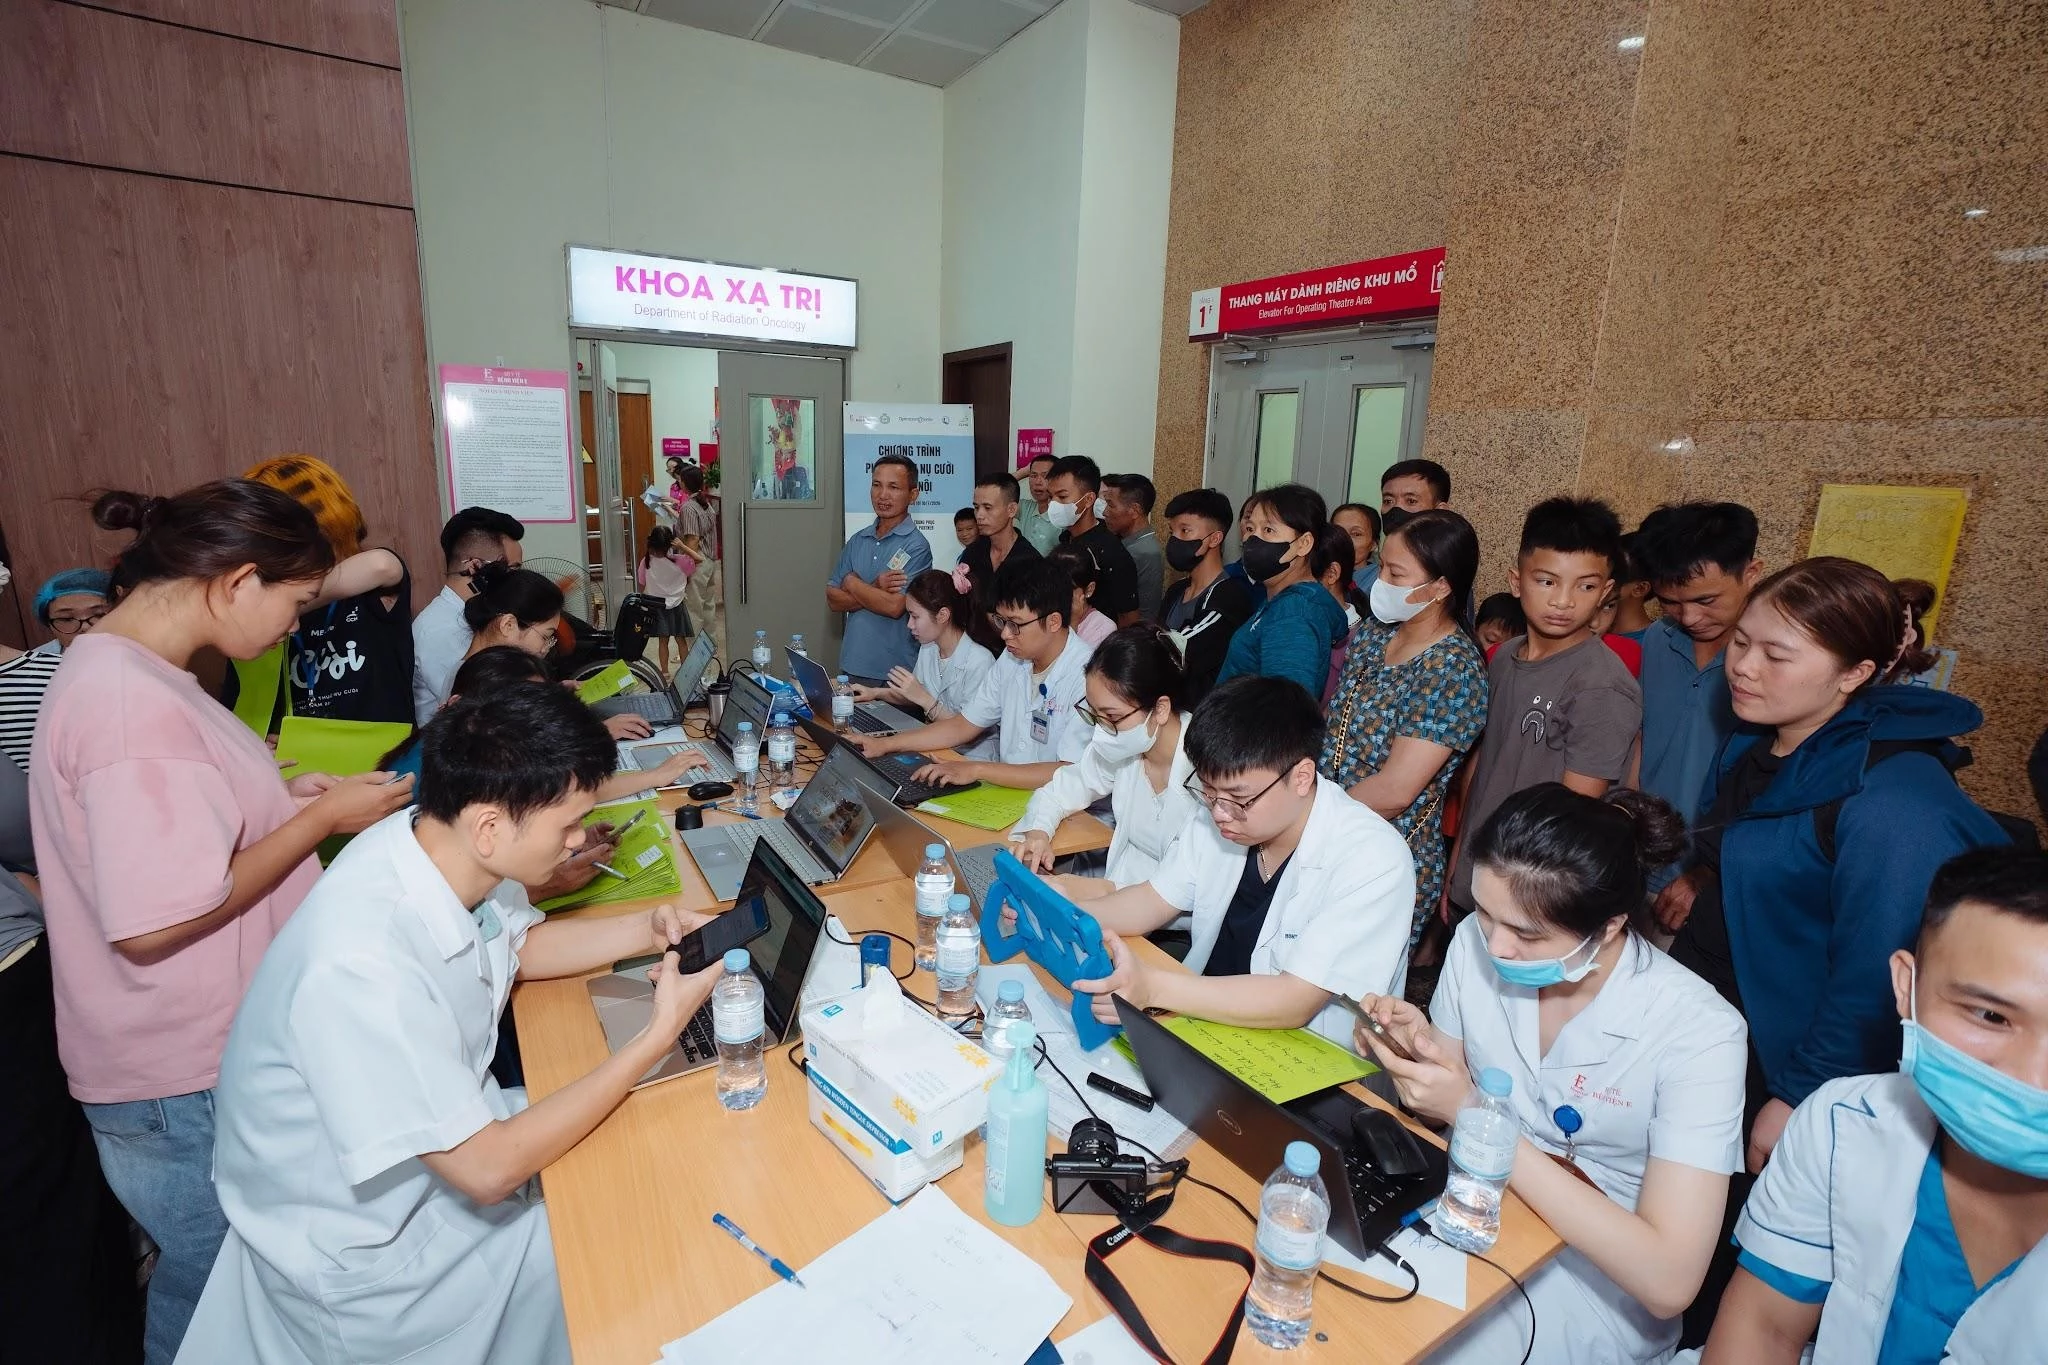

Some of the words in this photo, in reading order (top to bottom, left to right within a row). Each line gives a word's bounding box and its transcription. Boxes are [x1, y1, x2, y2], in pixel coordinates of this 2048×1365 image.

[615, 265, 714, 300] KHOA
[725, 278, 770, 313] XẠ
[779, 284, 821, 319] TRỊ
[1228, 295, 1262, 309] THANG
[1265, 286, 1287, 303] MÁY
[1290, 283, 1323, 300] DÀNH
[1325, 276, 1360, 294] RIÊNG
[1364, 271, 1391, 289] KHU
[1394, 260, 1418, 284] MỔ
[634, 303, 696, 321] Department
[699, 311, 711, 321] of
[712, 310, 759, 327] Radiation
[761, 315, 806, 332] Oncology
[1258, 307, 1282, 319] Elevator
[1284, 305, 1294, 316] For
[1296, 300, 1327, 315] Operating
[1329, 297, 1354, 309] Theatre
[1356, 295, 1373, 306] Area
[916, 443, 941, 457] TRÌNH
[920, 463, 931, 477] NỤ
[934, 461, 954, 475] CƯỜI
